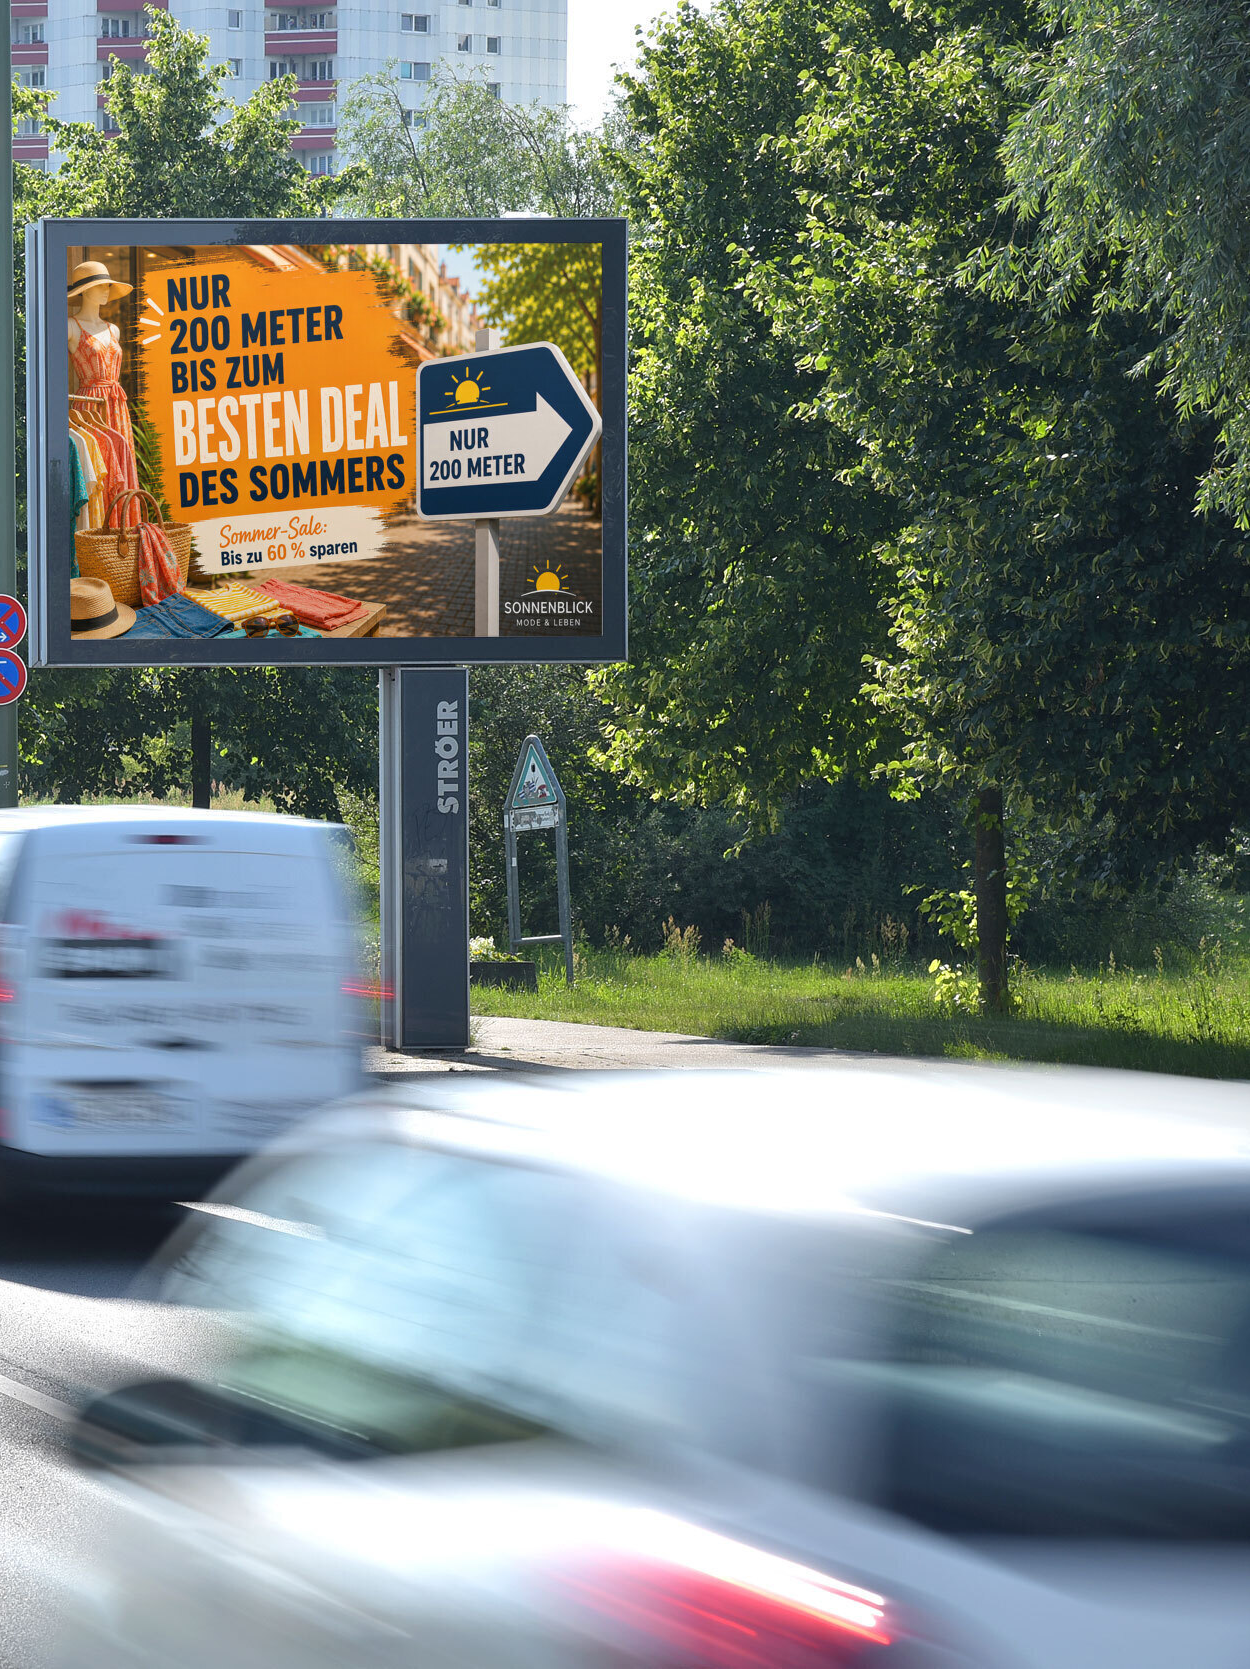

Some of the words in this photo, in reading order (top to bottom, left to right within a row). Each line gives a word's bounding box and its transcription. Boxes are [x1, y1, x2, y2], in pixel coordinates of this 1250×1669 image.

[167, 273, 231, 312] NUR
[169, 315, 230, 355] 200
[241, 304, 344, 348] METER
[171, 358, 217, 394] BIS
[225, 352, 285, 389] ZUM
[172, 389, 310, 466] BESTEN
[320, 380, 408, 453] DEAL
[449, 427, 489, 451] NUR
[179, 467, 239, 508] DES
[249, 453, 406, 502] SOMMERS
[429, 458, 462, 481] 200
[467, 453, 525, 478] METER
[219, 514, 327, 549] Sommer-Sale:
[220, 550, 243, 566] Bis
[246, 551, 262, 563] zu
[267, 543, 287, 561] 60
[290, 541, 306, 559] %
[309, 541, 358, 560] sparen
[504, 600, 594, 614] SONNENBLICK
[516, 618, 541, 627] MODE
[544, 618, 550, 627] &
[553, 618, 581, 627] LEBEN
[434, 700, 460, 814] STRÖER
